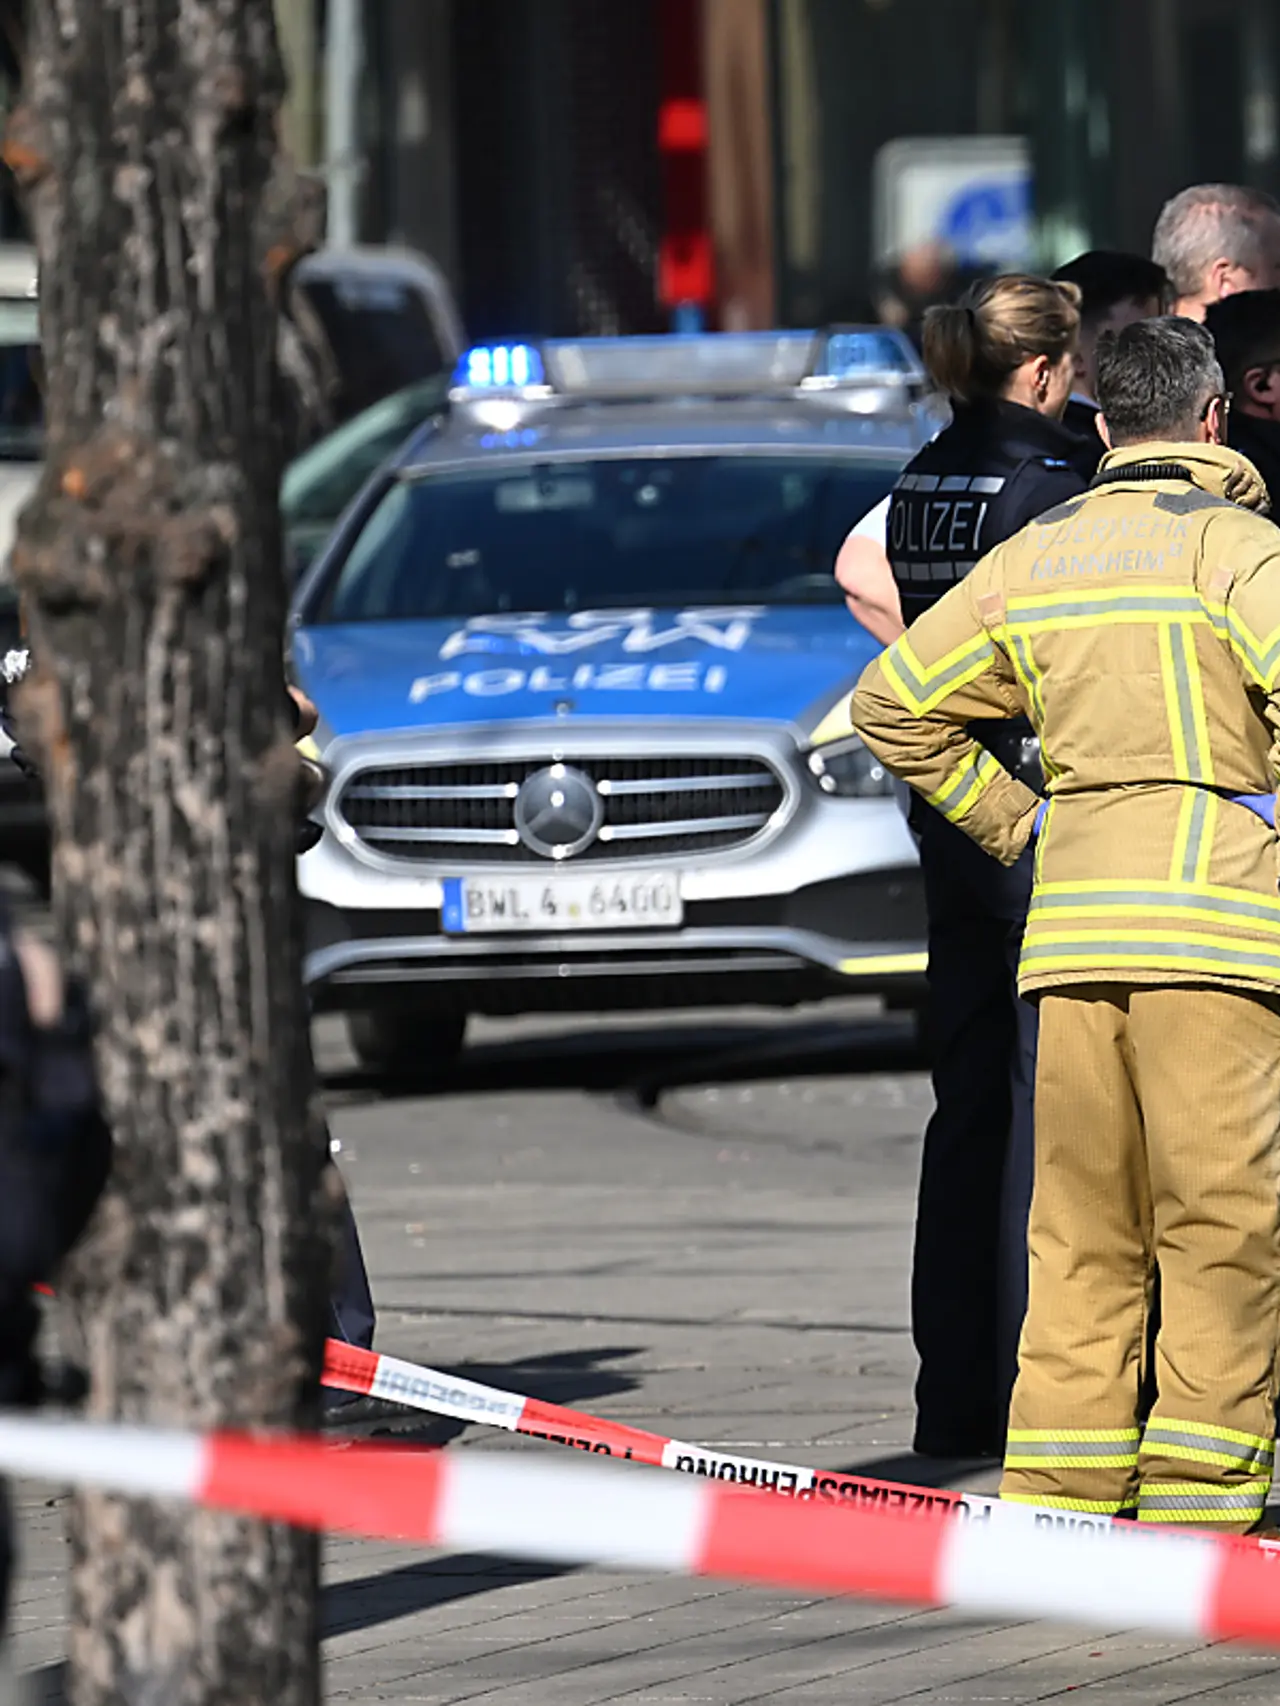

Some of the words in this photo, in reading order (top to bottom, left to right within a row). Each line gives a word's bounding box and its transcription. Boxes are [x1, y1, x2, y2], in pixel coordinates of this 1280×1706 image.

[889, 500, 988, 552] OLIZEI
[1019, 513, 1193, 549] FEUERWEHR
[1029, 548, 1165, 581] MANNHEIM
[408, 661, 728, 704] POLIZEI
